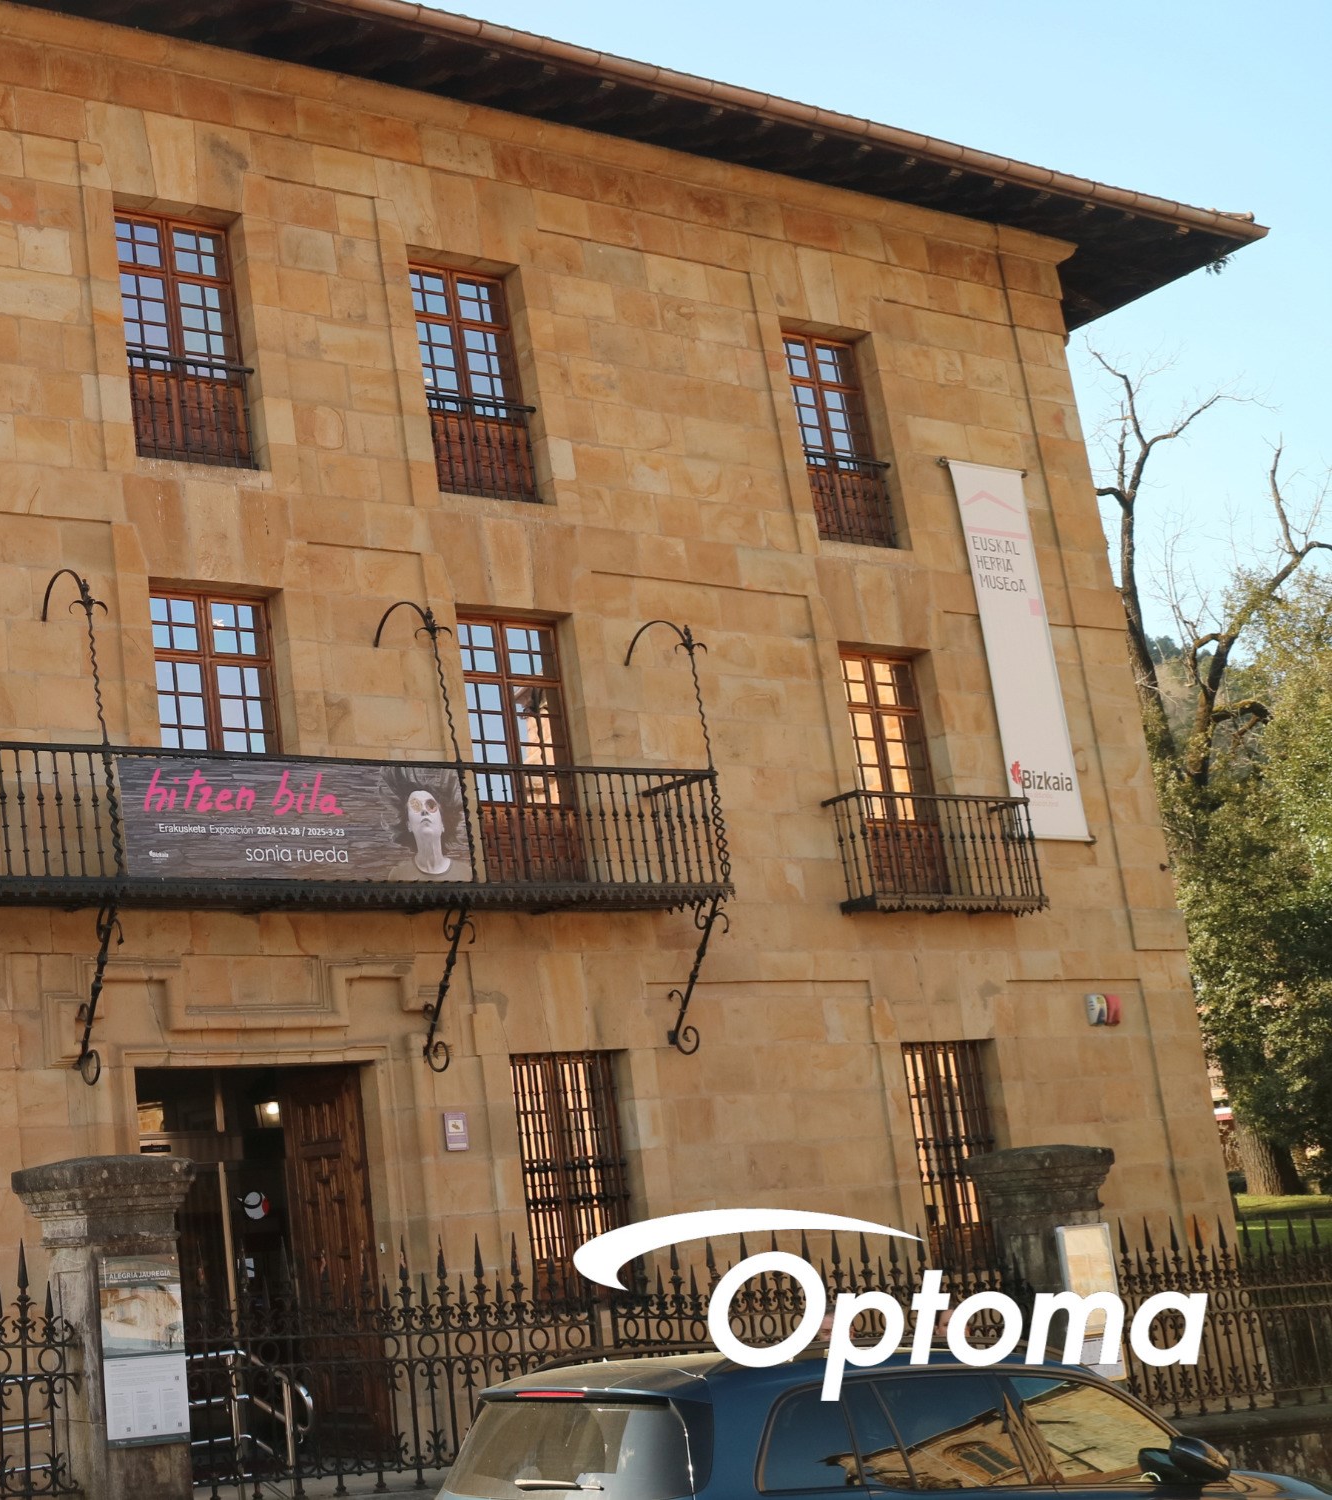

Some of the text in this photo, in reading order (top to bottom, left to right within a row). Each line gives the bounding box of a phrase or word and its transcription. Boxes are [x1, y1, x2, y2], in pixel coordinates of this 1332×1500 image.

[972, 536, 1020, 556] EUSKAL
[975, 555, 1014, 573] HERRIA
[1022, 769, 1073, 791] Bizkaia
[143, 768, 344, 816] hitzen bila
[158, 823, 206, 834] Erakusketa
[209, 824, 254, 836] Exposición
[256, 826, 301, 836] 2024-11-28
[307, 827, 345, 837] 2025-3-23
[245, 845, 349, 863] sonia rueda
[109, 1272, 138, 1280] ALEGRIA
